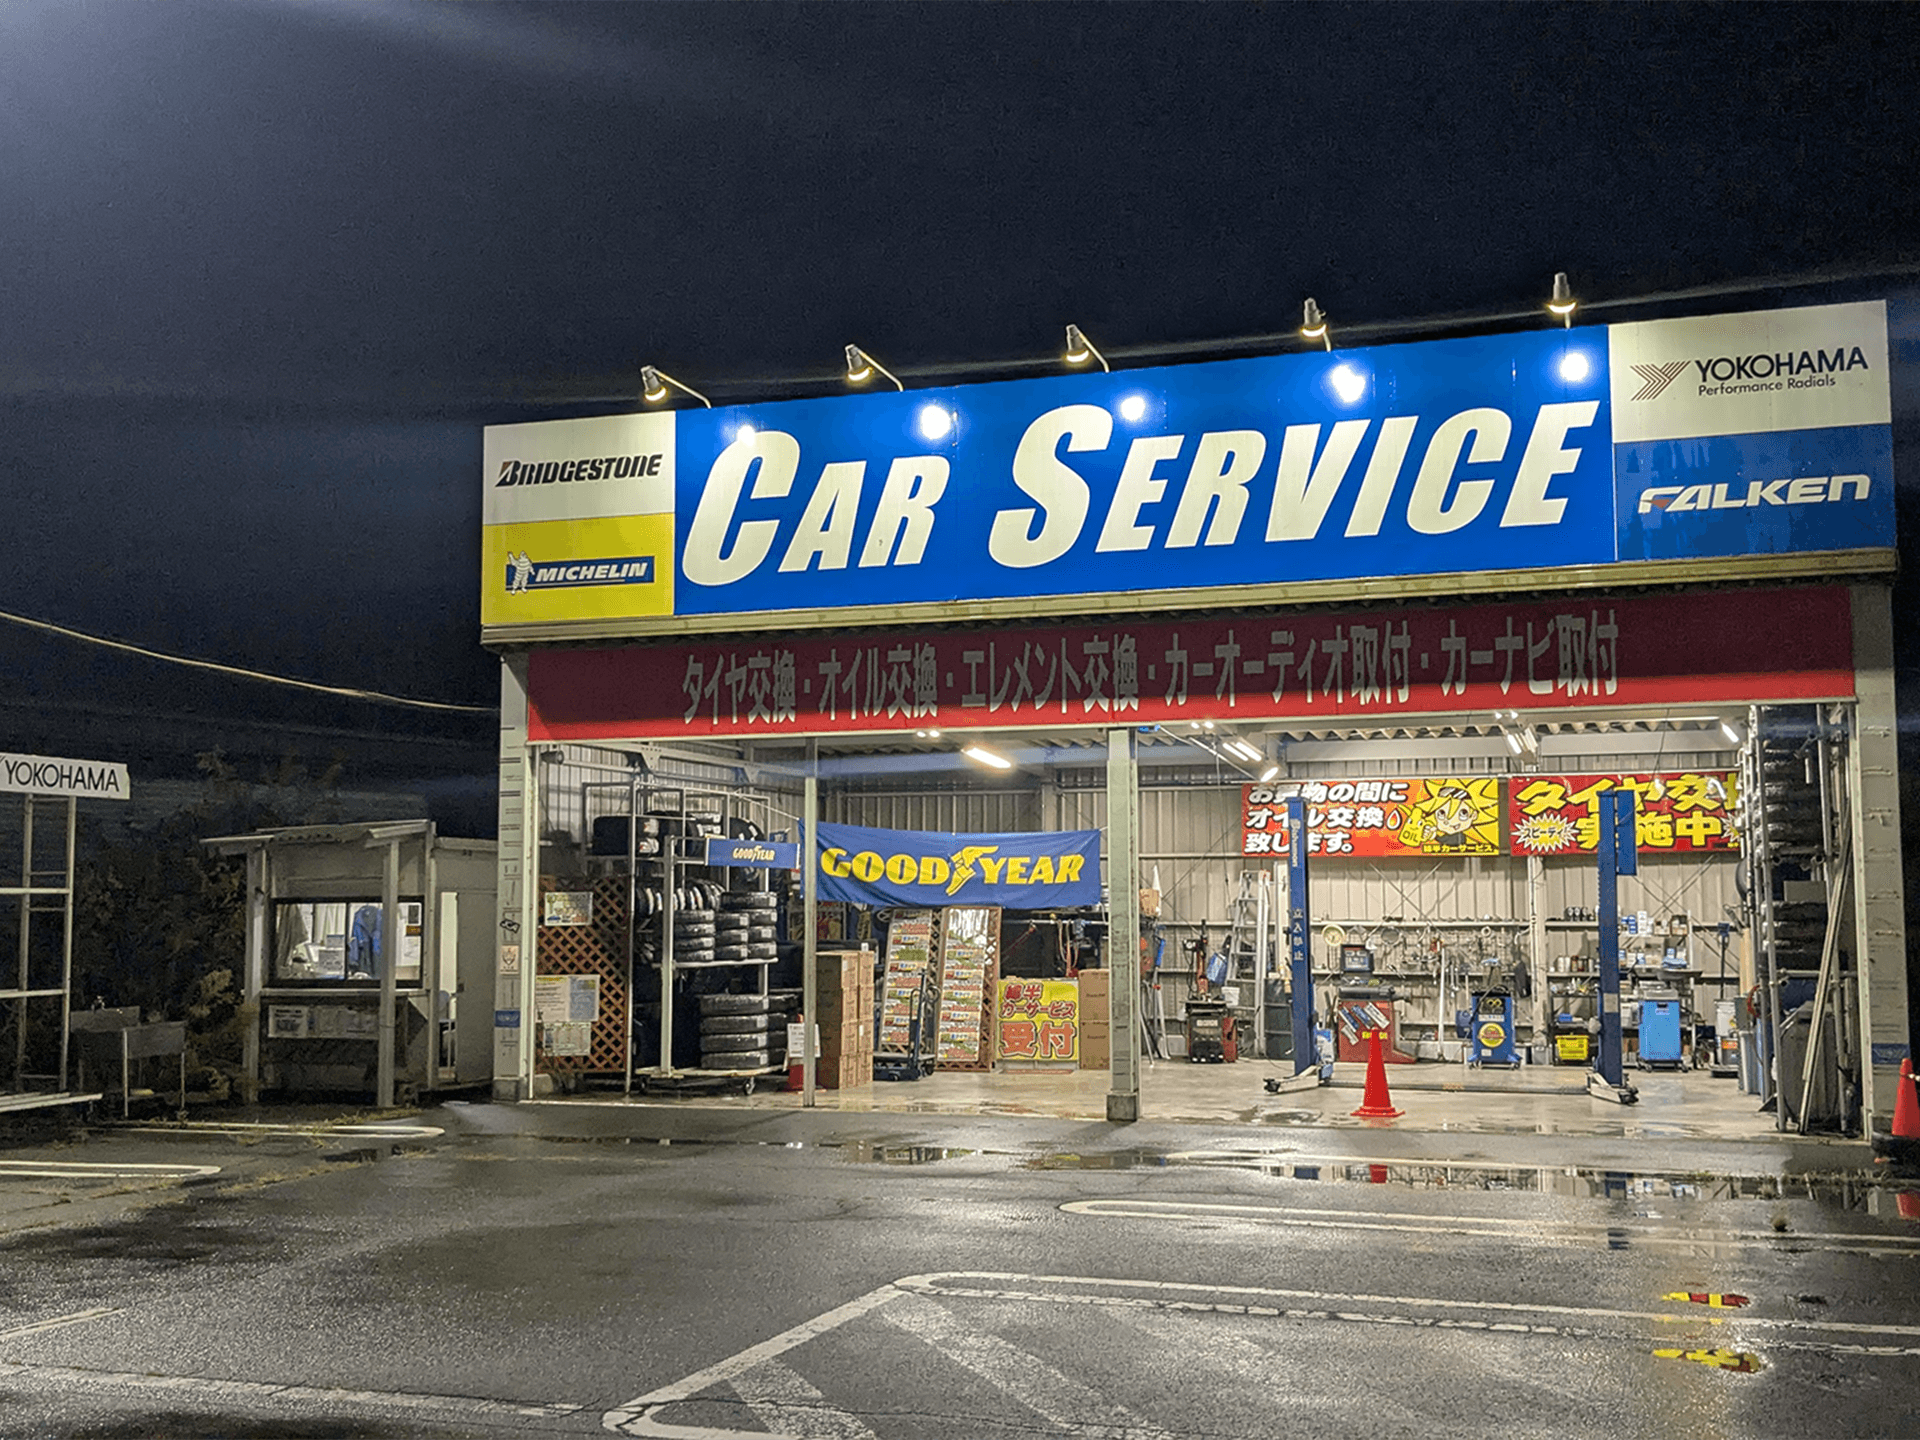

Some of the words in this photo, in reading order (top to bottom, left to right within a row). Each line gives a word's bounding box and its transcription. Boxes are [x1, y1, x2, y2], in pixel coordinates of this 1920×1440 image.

[1695, 347, 1869, 383] YOKOHAMA
[1698, 381, 1783, 397] Performance
[1787, 376, 1836, 390] Radials
[495, 453, 664, 488] BRIDGESTONE
[682, 430, 952, 586] CAR
[988, 400, 1601, 569] SERVICE
[1637, 474, 1871, 514] FALKEN
[537, 562, 647, 582] MICHELIN
[5, 759, 120, 792] YOKOHAMA
[1402, 831, 1419, 843] OIL
[1000, 1001, 1075, 1018] カーサービス
